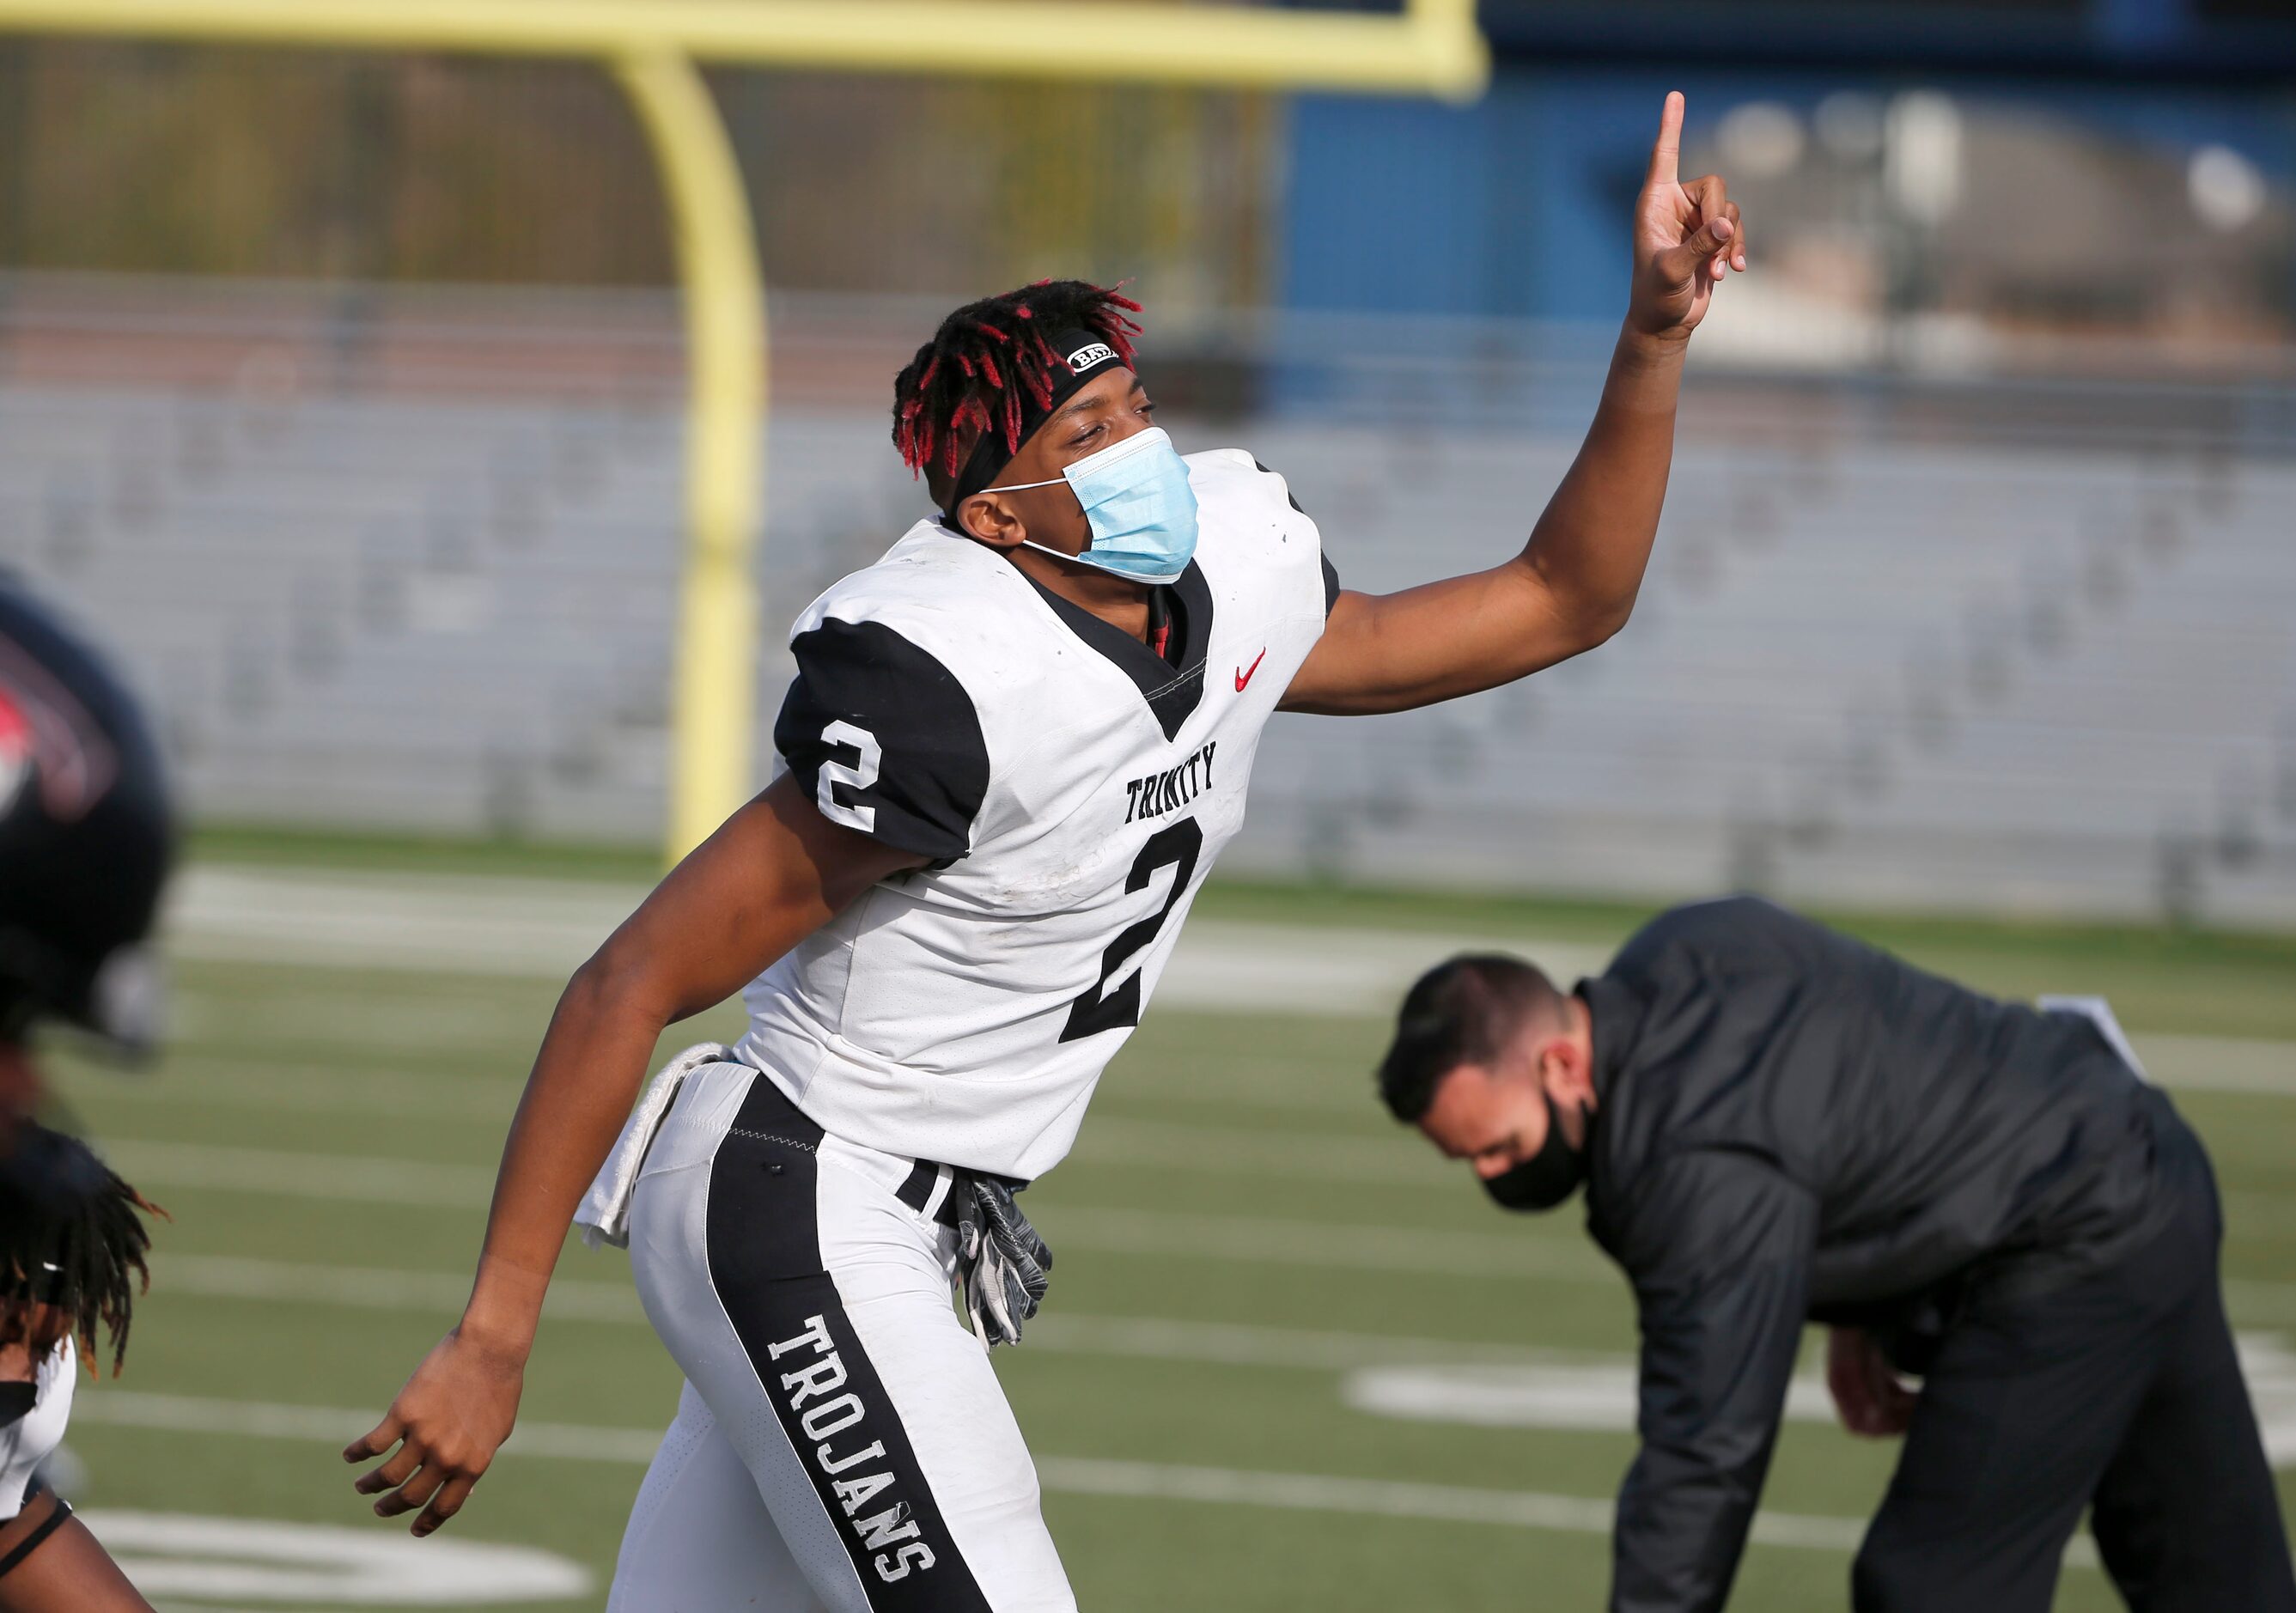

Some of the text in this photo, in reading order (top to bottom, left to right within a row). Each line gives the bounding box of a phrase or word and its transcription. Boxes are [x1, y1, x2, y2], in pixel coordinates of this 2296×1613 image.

[818, 720, 882, 832] 2
[1125, 741, 1216, 825] TRINITY
[1058, 816, 1203, 1044] 2
[767, 1314, 935, 1583] TROJANS
